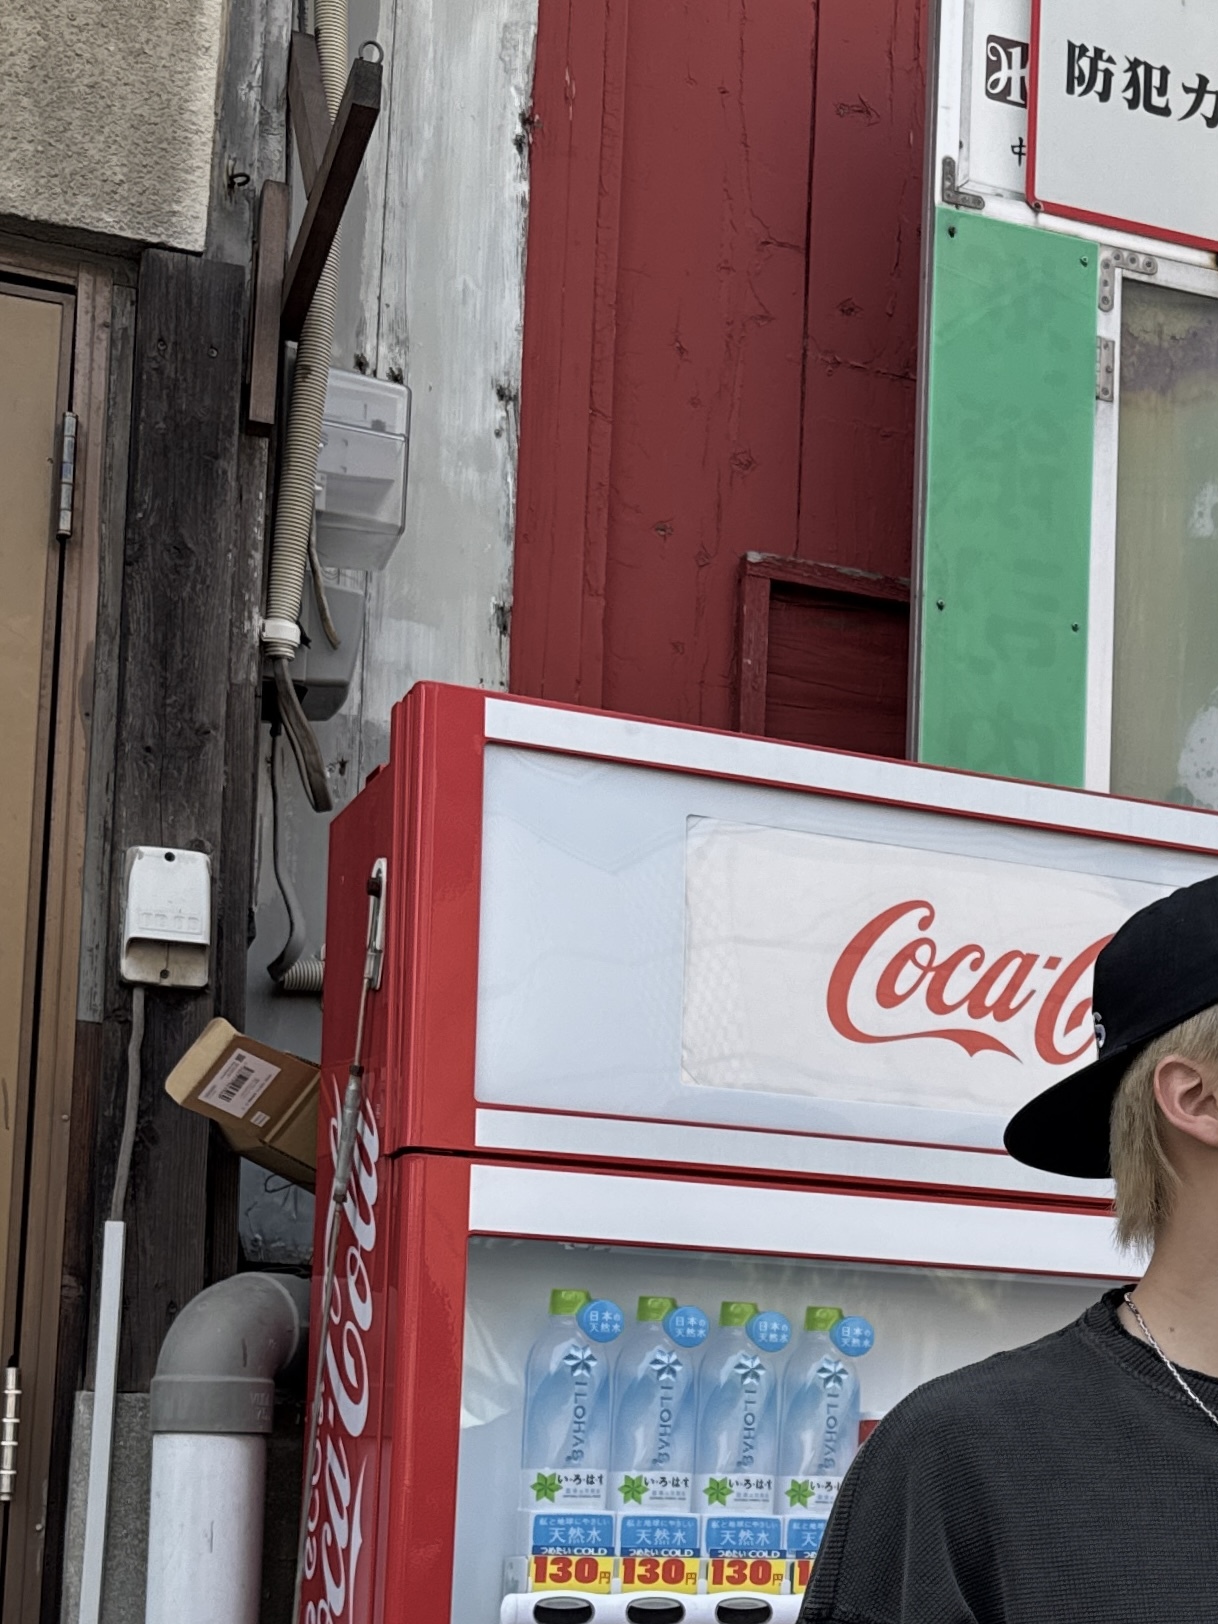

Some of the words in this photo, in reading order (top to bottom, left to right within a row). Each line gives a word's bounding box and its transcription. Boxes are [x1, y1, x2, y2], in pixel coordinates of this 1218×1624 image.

[827, 899, 1114, 1066] Coca-C
[589, 1310, 621, 1322] 日本の
[675, 1316, 706, 1327] 日本の
[758, 1321, 789, 1332] 日本の
[841, 1326, 871, 1337] 日本の
[548, 1527, 602, 1544] 天然水
[635, 1528, 687, 1546] 天然水
[720, 1529, 771, 1547] 天然水
[573, 1547, 608, 1556] COLD
[660, 1548, 695, 1558] COLD
[748, 1550, 781, 1559] COLD
